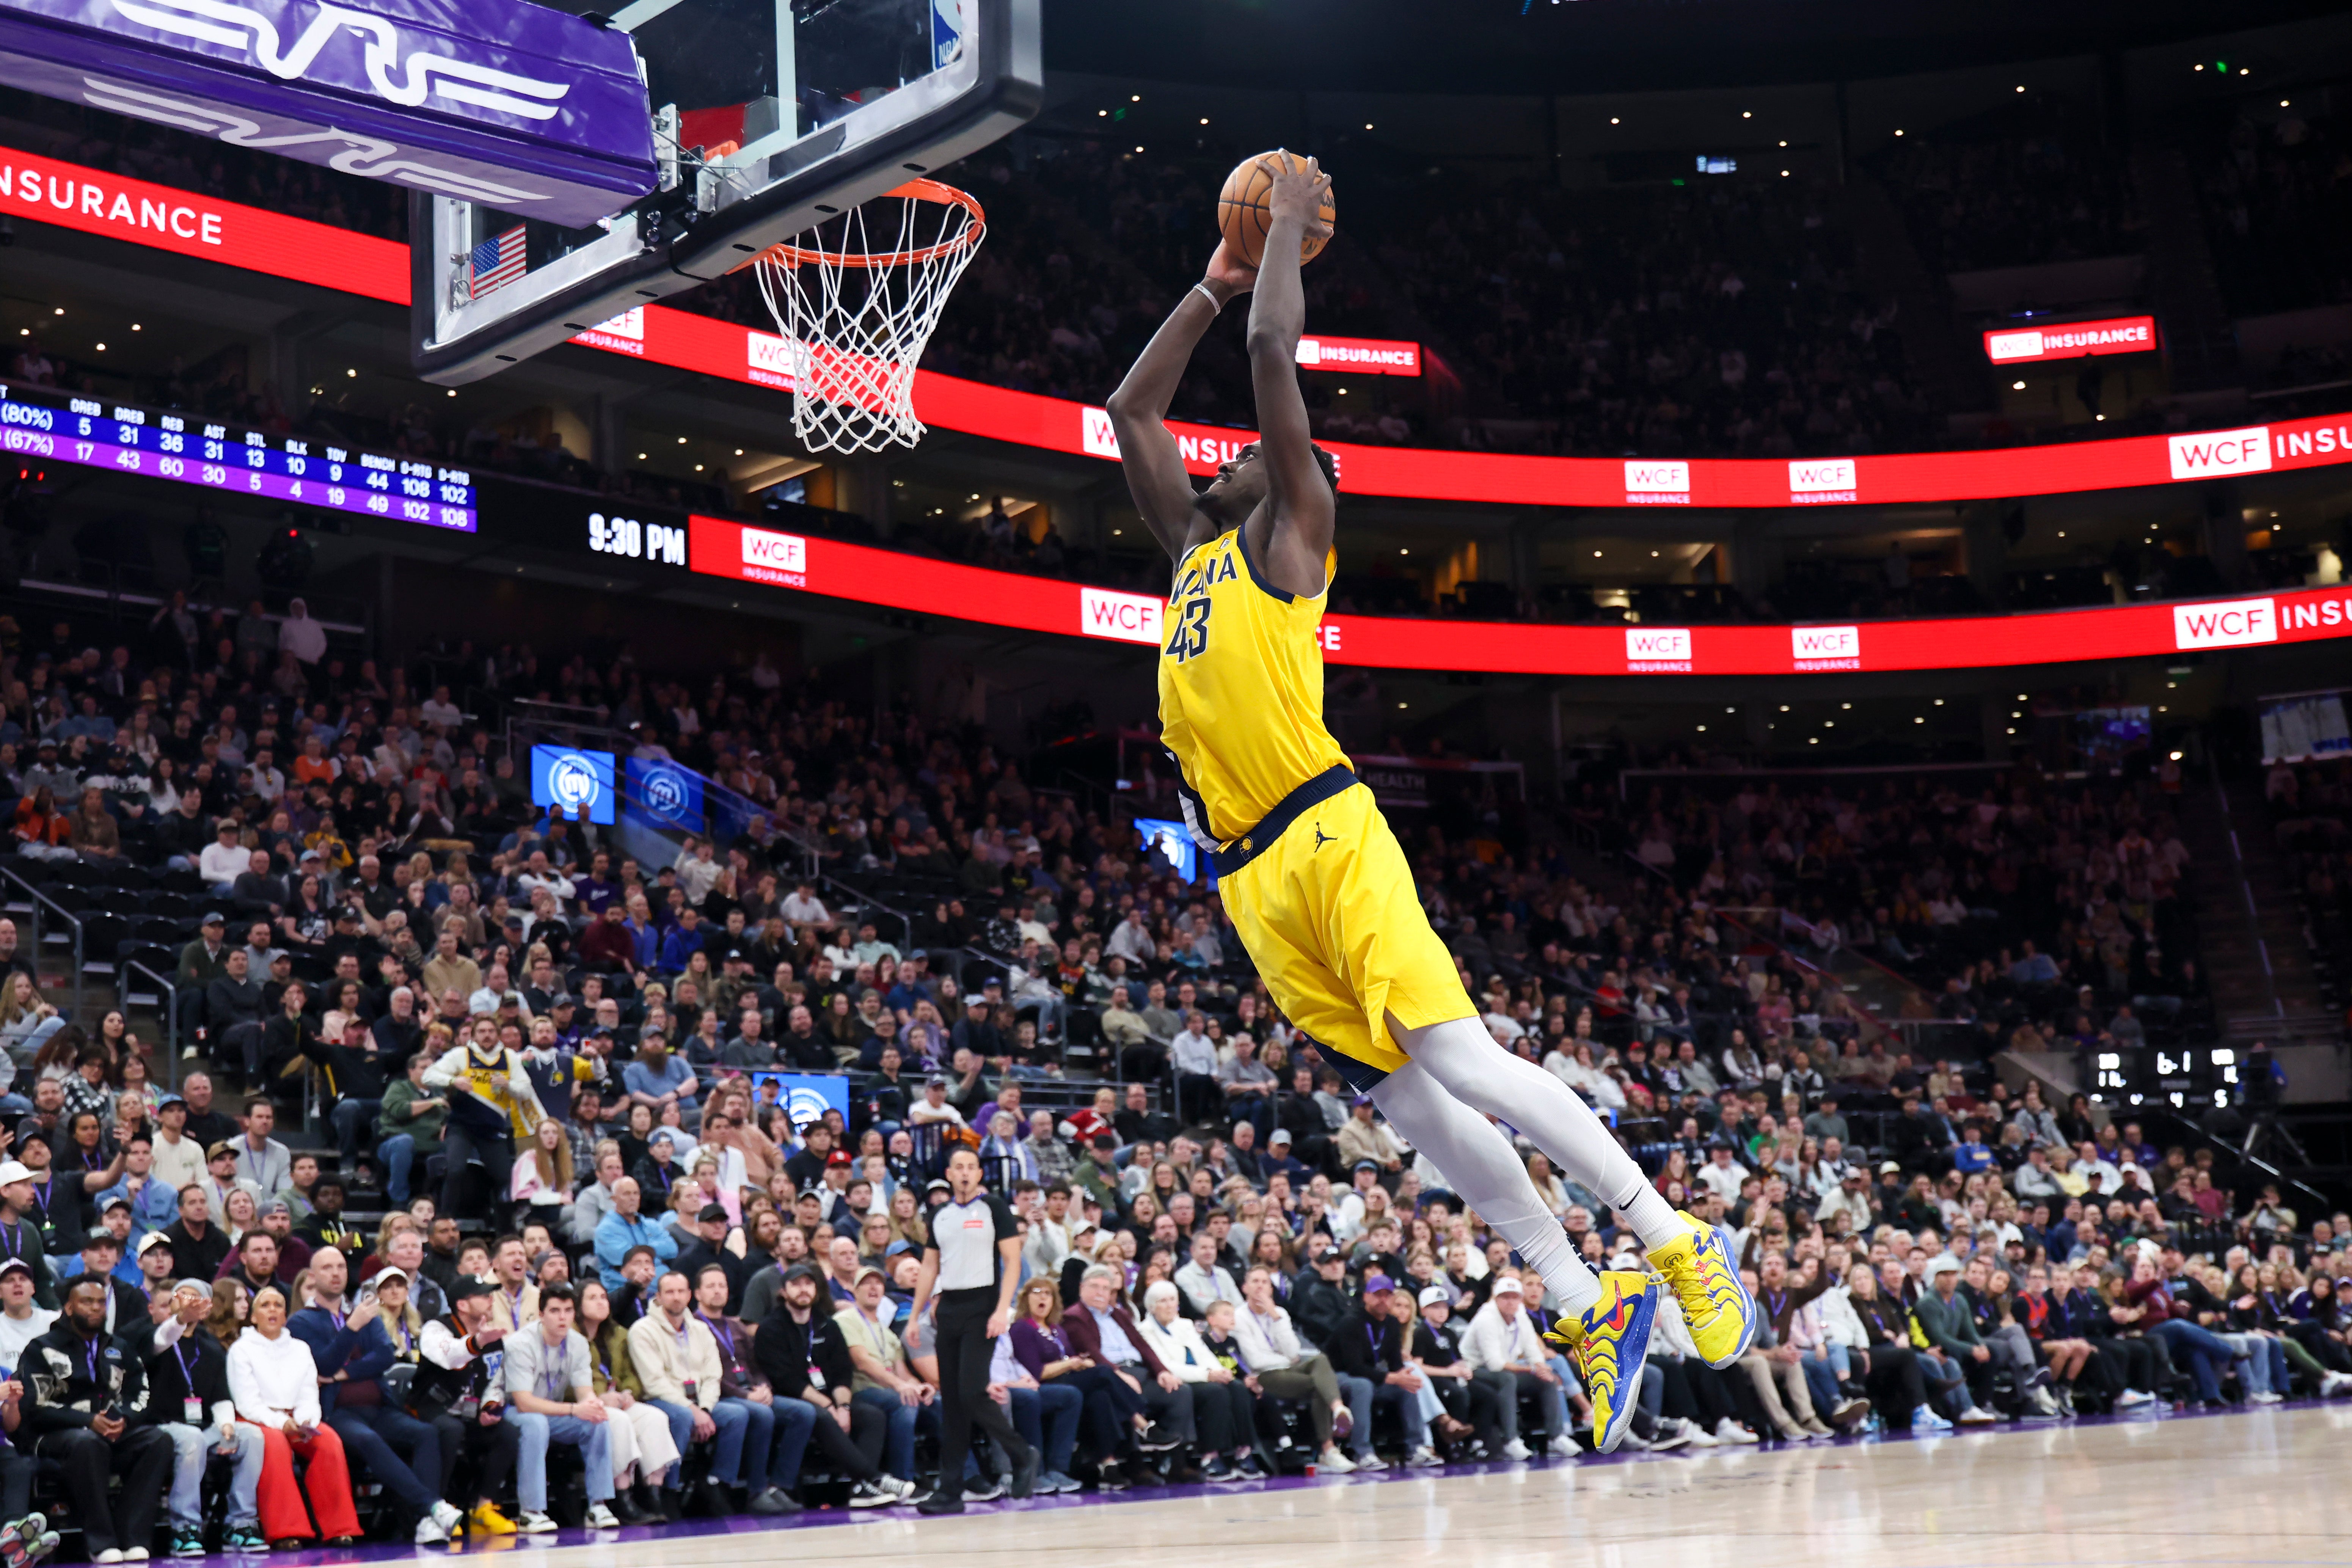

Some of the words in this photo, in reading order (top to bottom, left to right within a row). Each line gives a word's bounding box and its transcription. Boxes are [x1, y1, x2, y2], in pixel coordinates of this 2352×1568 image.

[2044, 326, 2148, 350] INSURANCE
[1320, 346, 1415, 366] INSURANCE
[1, 402, 53, 431] (80%)
[79, 417, 91, 436] 5
[119, 425, 138, 445] 31
[160, 432, 184, 453] 36
[204, 441, 223, 460] 31
[246, 449, 265, 468] 13
[286, 456, 306, 475] 10
[330, 464, 342, 482] 9
[366, 471, 389, 490] 44
[401, 477, 430, 498] 108
[440, 484, 468, 505] 102
[161, 415, 184, 432] REB
[203, 423, 226, 440] AST
[246, 431, 267, 448] STL
[286, 439, 308, 456] BLK
[326, 446, 347, 463] TOV
[360, 453, 396, 472] BENCH
[2181, 438, 2258, 468] WCF
[4, 429, 54, 456] (67%)
[75, 443, 94, 461] 17
[116, 450, 141, 470] 43
[159, 457, 184, 477] 60
[202, 464, 226, 485] 30
[250, 472, 262, 491] 5
[290, 480, 303, 498] 4
[327, 487, 345, 505] 19
[367, 494, 389, 513] 49
[403, 501, 430, 521] 102
[440, 507, 468, 527] 108
[1633, 469, 1680, 485] WCF
[1797, 467, 1846, 484] WCF
[1625, 493, 1691, 504] INSURANCE
[1790, 491, 1857, 504] INSURANCE
[589, 513, 641, 557] 9:30
[646, 523, 685, 566] PM
[750, 537, 799, 563] WCF
[742, 565, 807, 588] INSURANCE
[1091, 599, 1154, 631] WCF
[2186, 609, 2264, 638] WCF
[1163, 596, 1212, 665] 43
[1634, 637, 1683, 653] WCF
[1800, 634, 1850, 651] WCF
[1627, 661, 1693, 672] INSURANCE
[1793, 659, 1861, 671] INSURANCE
